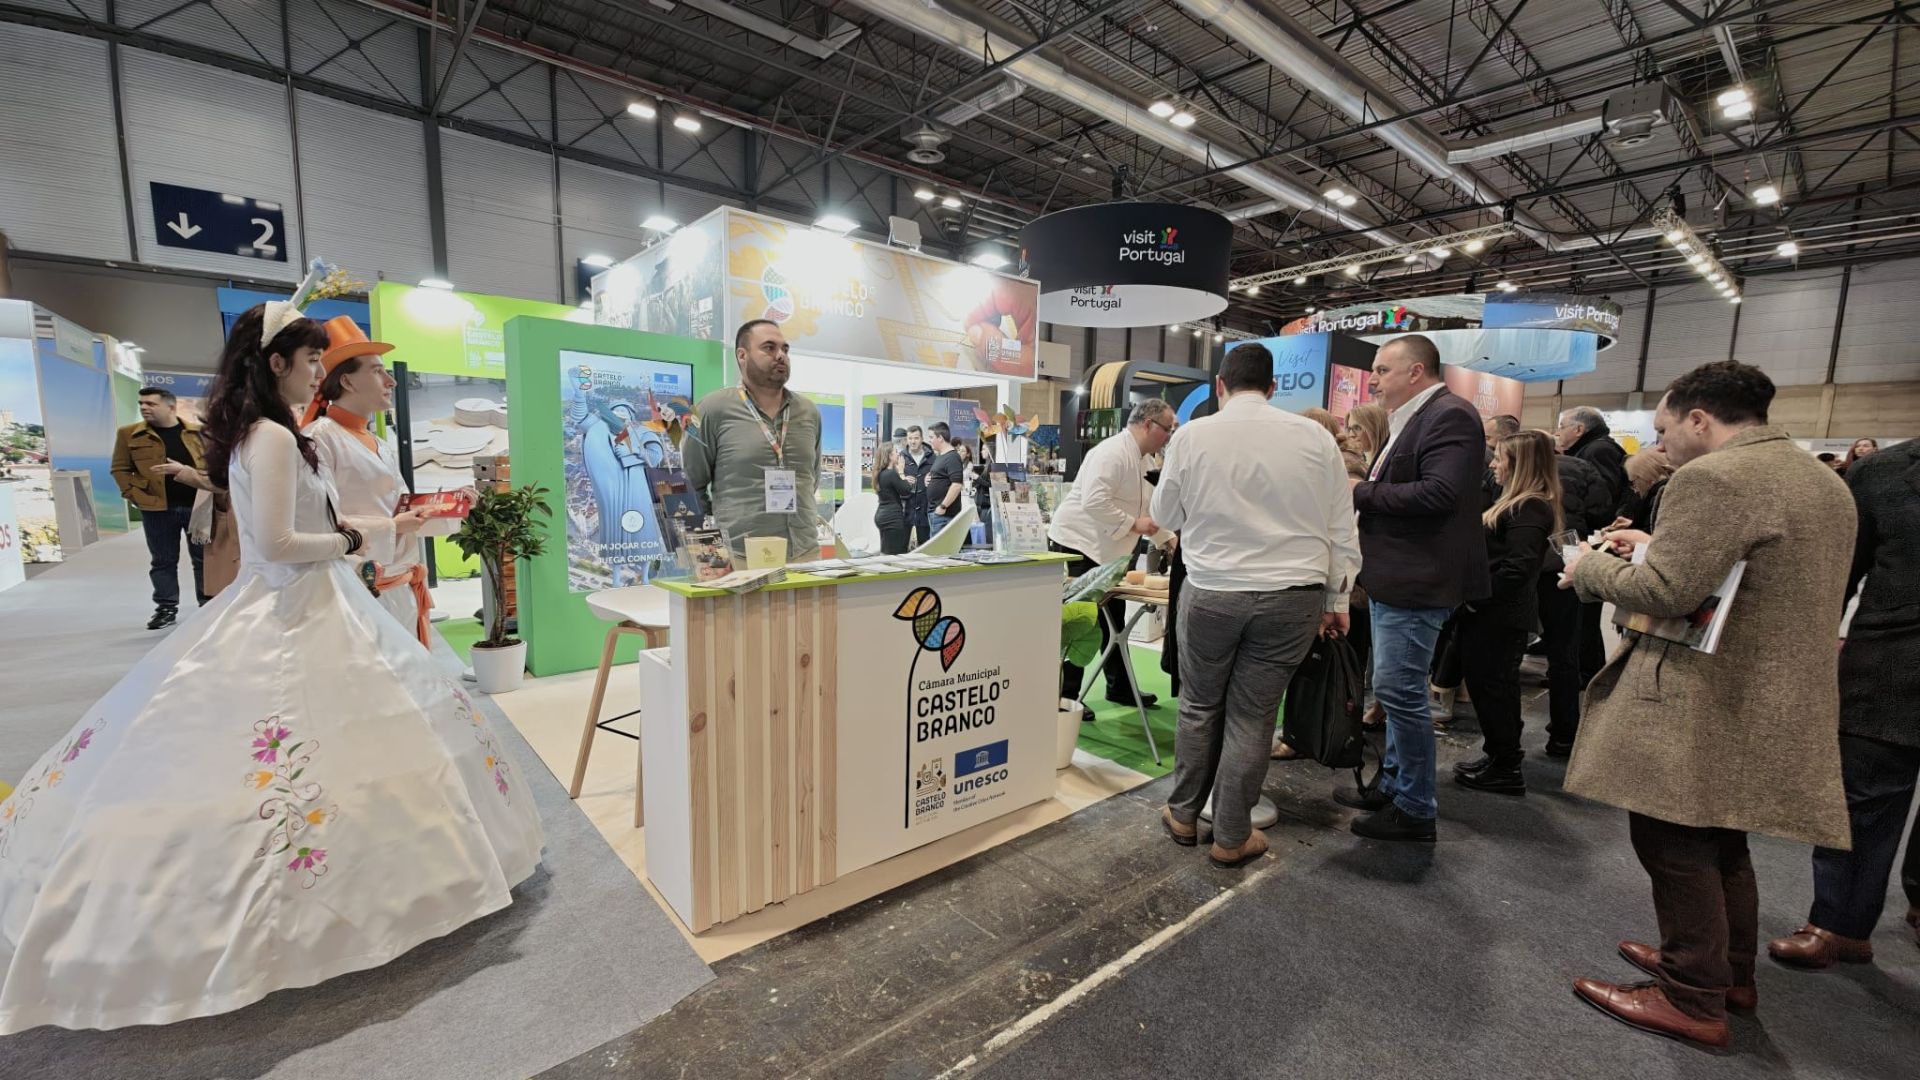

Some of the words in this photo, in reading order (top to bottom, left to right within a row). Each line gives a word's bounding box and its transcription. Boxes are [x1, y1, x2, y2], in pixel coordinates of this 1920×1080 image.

[251, 218, 277, 252] 2
[1123, 230, 1156, 245] visit
[1119, 247, 1185, 265] Portugal
[1070, 296, 1121, 311] Portugal
[1555, 303, 1584, 320] visit
[1318, 310, 1382, 334] Portugal
[609, 542, 639, 550] JOGAR
[599, 556, 626, 565] JUEGA
[918, 676, 955, 691] Câmara
[957, 666, 1001, 684] Municipal
[917, 681, 1000, 718] CASTELO
[917, 705, 995, 743] BRANCO
[953, 768, 1009, 796] unesco
[915, 791, 946, 808] CASTELO
[915, 800, 945, 816] BRANCO
